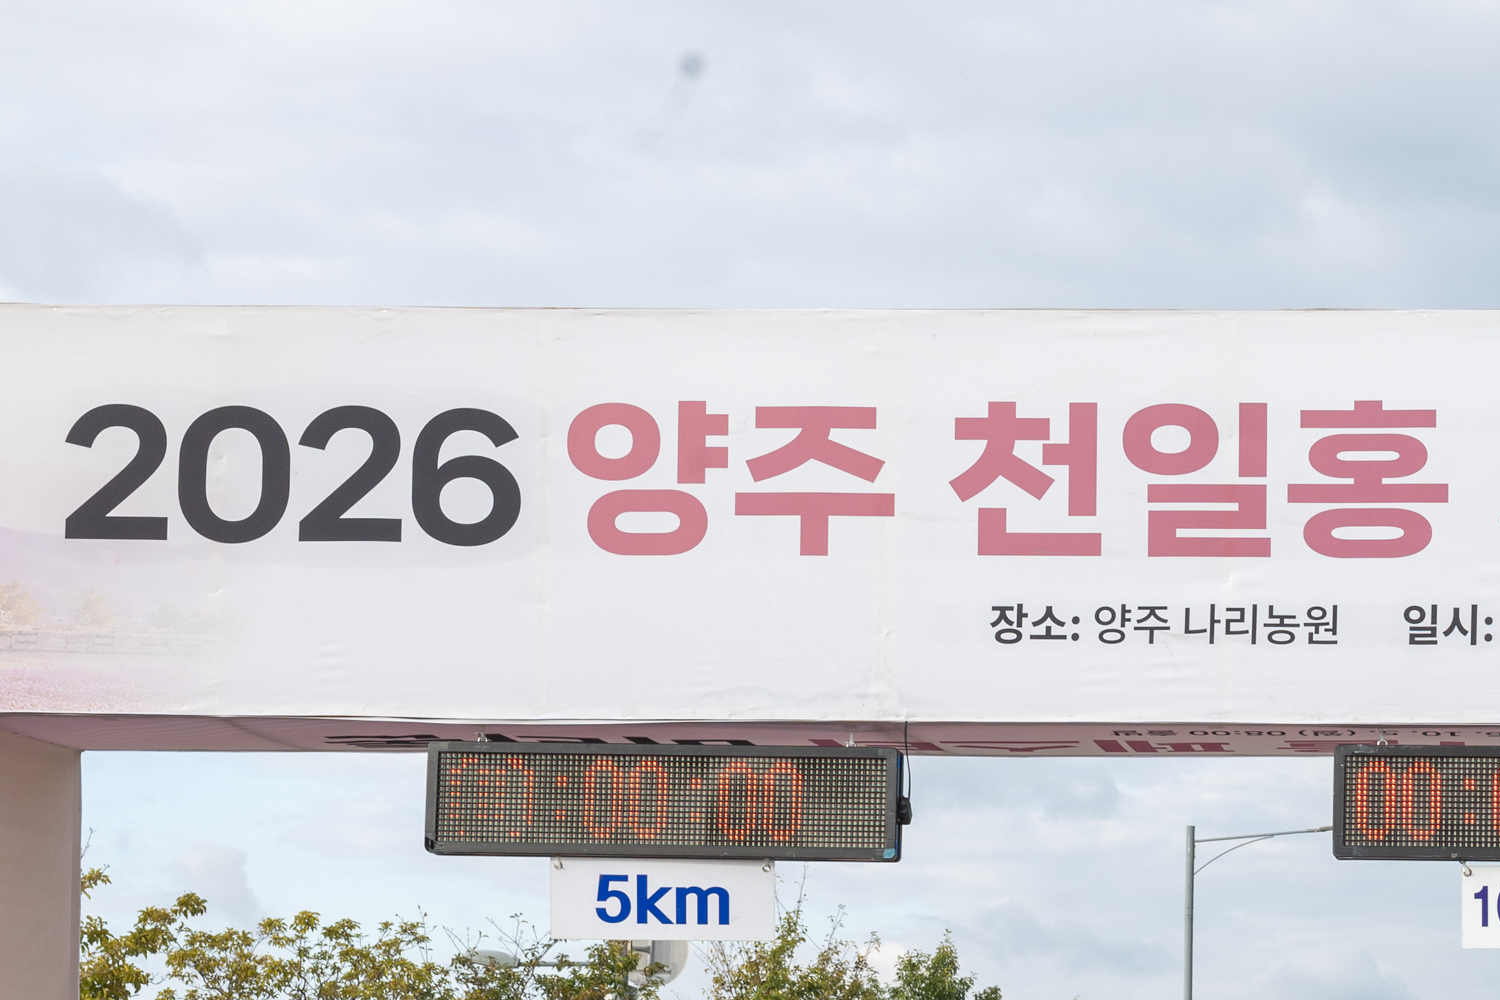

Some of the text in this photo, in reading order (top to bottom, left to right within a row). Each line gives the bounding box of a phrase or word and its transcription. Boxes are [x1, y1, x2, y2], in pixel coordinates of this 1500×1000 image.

[65, 403, 521, 547] 2026
[567, 400, 895, 556] 양주
[949, 400, 1449, 558] 천일홍
[990, 604, 1080, 645] 장소:
[1094, 605, 1171, 645] 양주
[1183, 604, 1339, 645] 나리농원
[1403, 605, 1493, 645] 일시:
[595, 874, 731, 926] 5km
